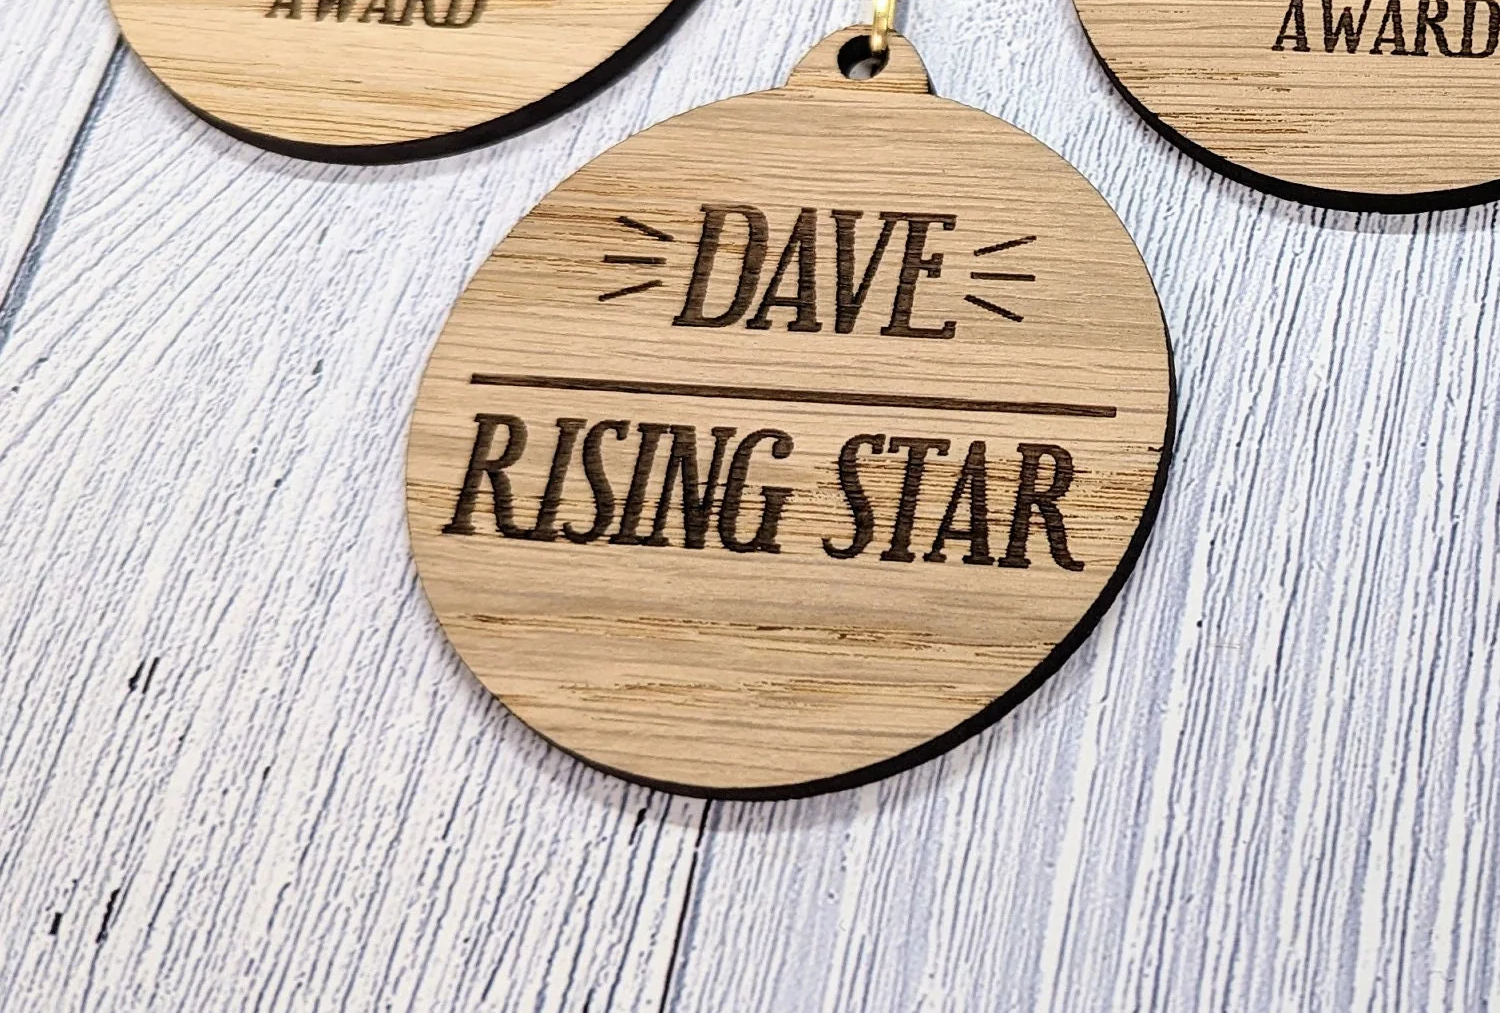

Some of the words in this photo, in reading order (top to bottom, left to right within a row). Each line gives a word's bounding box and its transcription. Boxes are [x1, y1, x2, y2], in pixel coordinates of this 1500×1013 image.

[673, 204, 957, 339] DAVE
[440, 413, 795, 554] RISING
[822, 434, 1087, 572] STAR
